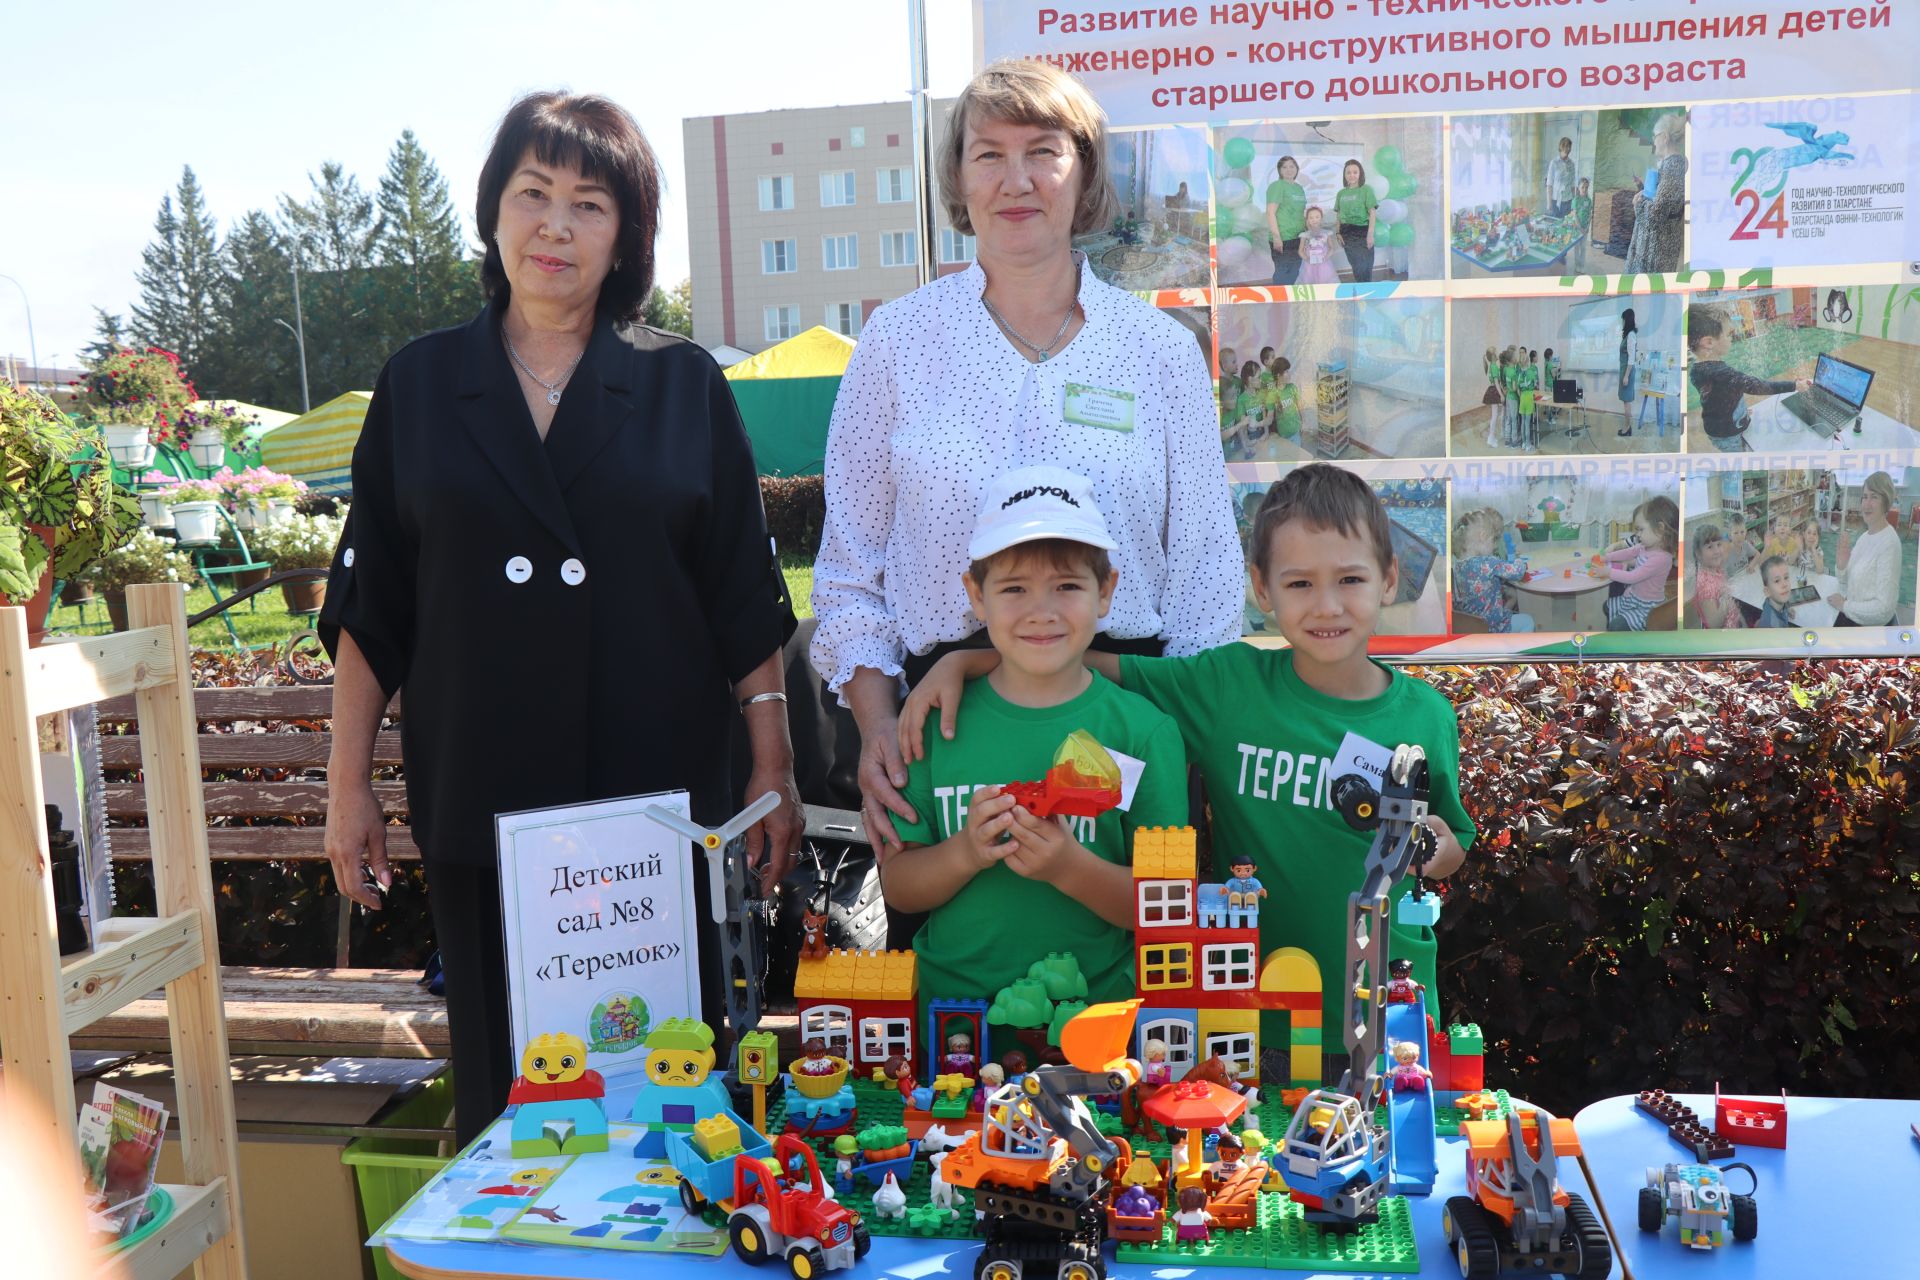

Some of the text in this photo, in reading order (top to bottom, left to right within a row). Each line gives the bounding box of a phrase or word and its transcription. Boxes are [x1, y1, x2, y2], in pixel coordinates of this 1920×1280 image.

[1024, 43, 1215, 74] нженерно
[1248, 27, 1550, 64] конструктивного
[1564, 12, 1767, 47] мышления
[1778, 0, 1891, 40] детей
[1038, 5, 1198, 35] Развитие
[1210, 0, 1334, 30] научно
[1346, 3, 1358, 11] -
[1151, 57, 1747, 110] старшего дошкольного возраста
[1791, 182, 1905, 200] ГОД НАУЧНО-ТЕХНОЛОГИЧЕСКОГО
[1791, 197, 1873, 212] РАЗВИТИЯ В ТАТАРСТАНЕ
[1728, 188, 1790, 241] 24
[1791, 214, 1834, 226] ТАТАРСТАНДА
[1811, 226, 1826, 238] ЕЛЫ
[551, 853, 663, 898] Детский
[557, 896, 655, 935] сад №8
[536, 941, 681, 982] «Теремок»
